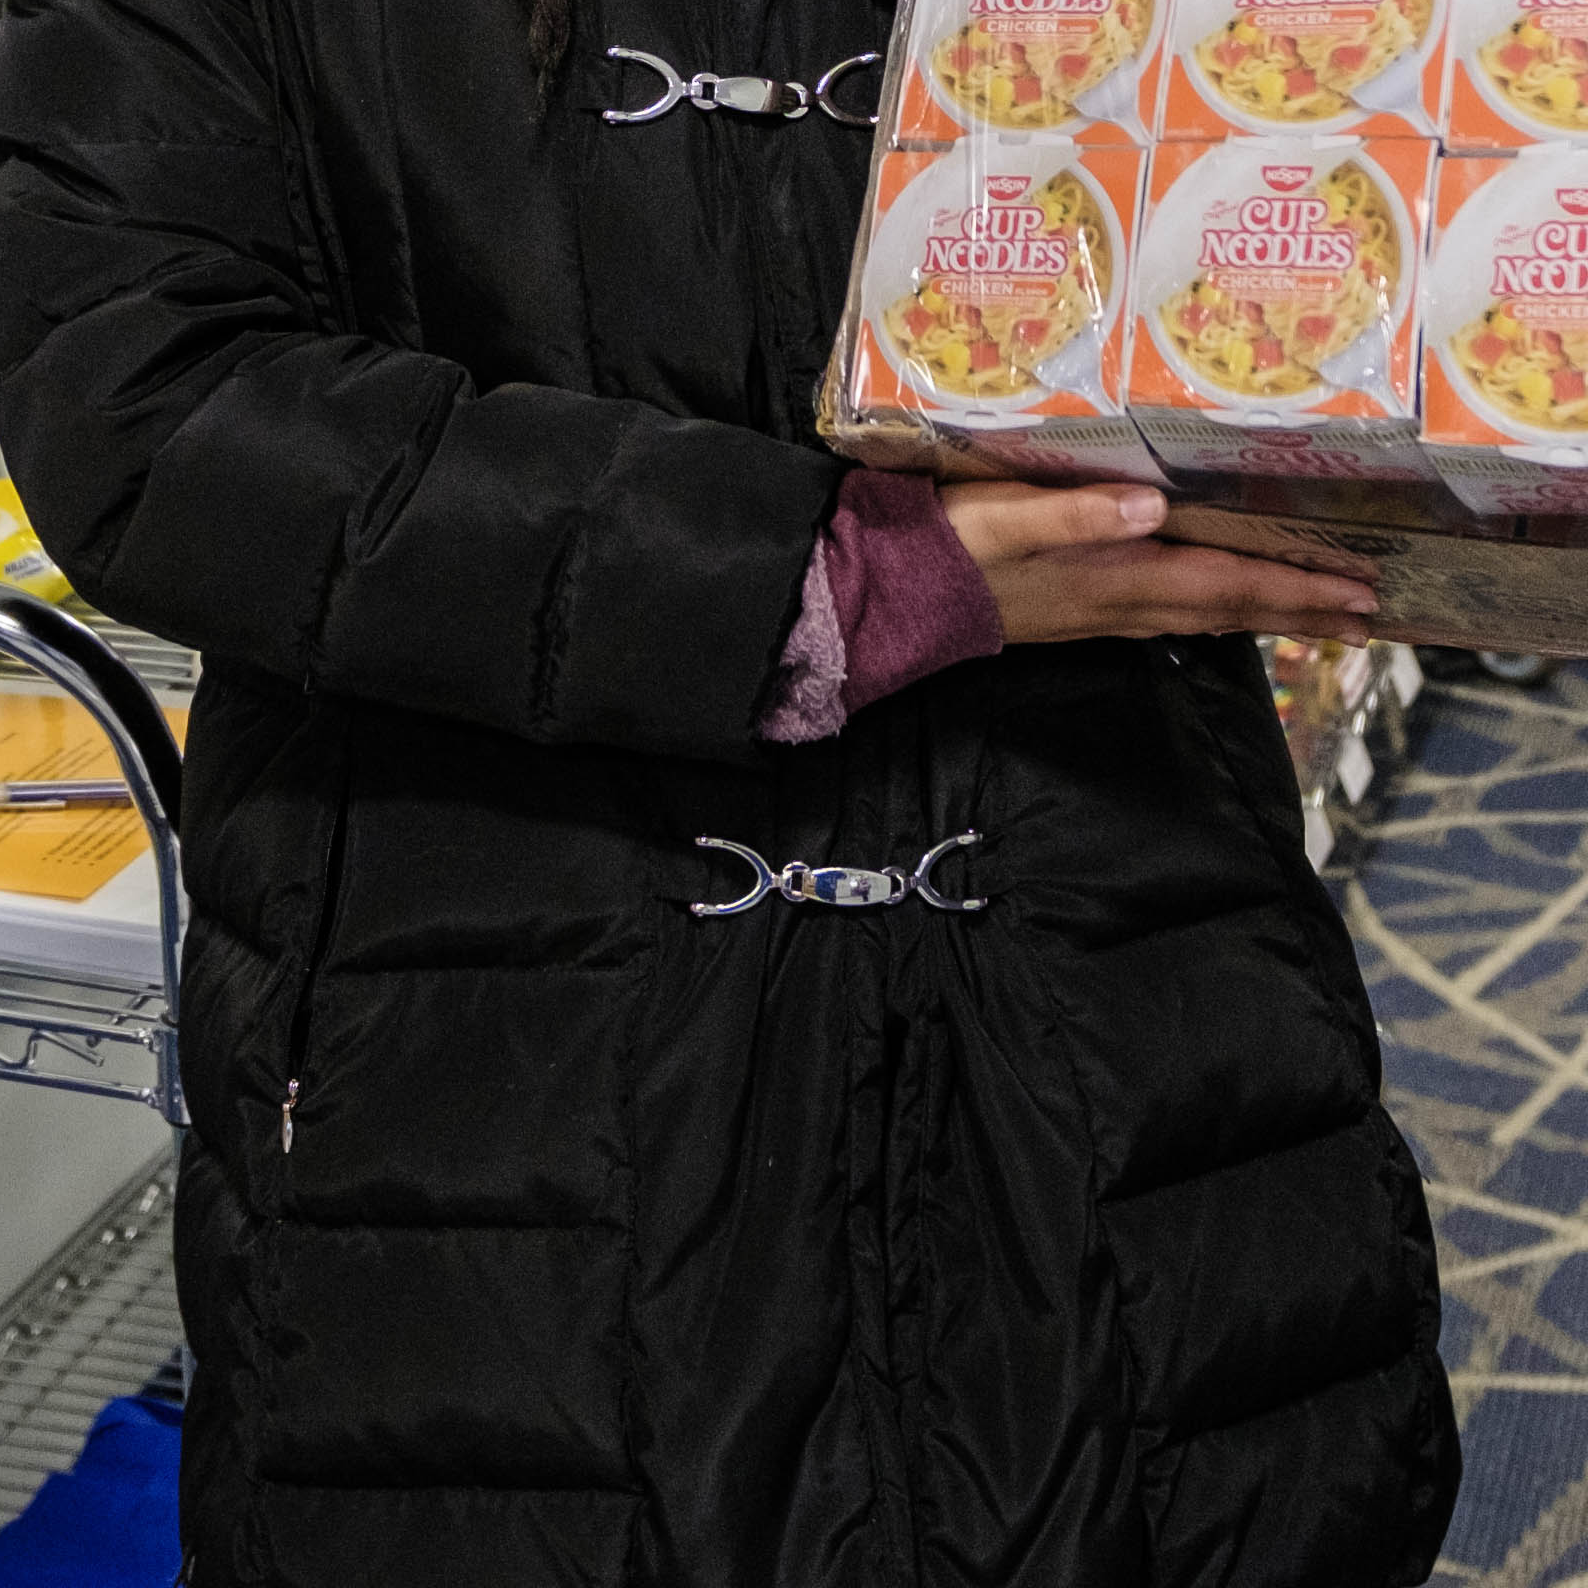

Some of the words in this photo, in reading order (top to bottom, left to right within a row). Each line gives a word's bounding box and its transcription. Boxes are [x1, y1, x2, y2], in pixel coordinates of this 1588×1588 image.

[987, 20, 1058, 32] CHICKEN
[1265, 169, 1309, 183] NISSIN
[987, 178, 1027, 193] NISSIN
[1240, 196, 1328, 233] CUP
[962, 206, 1044, 240] CUP
[921, 237, 1068, 275] NOODLES
[1198, 230, 1354, 270] NOODLES
[940, 281, 1012, 295] CHICKEN
[1218, 276, 1297, 290] CHICKEN
